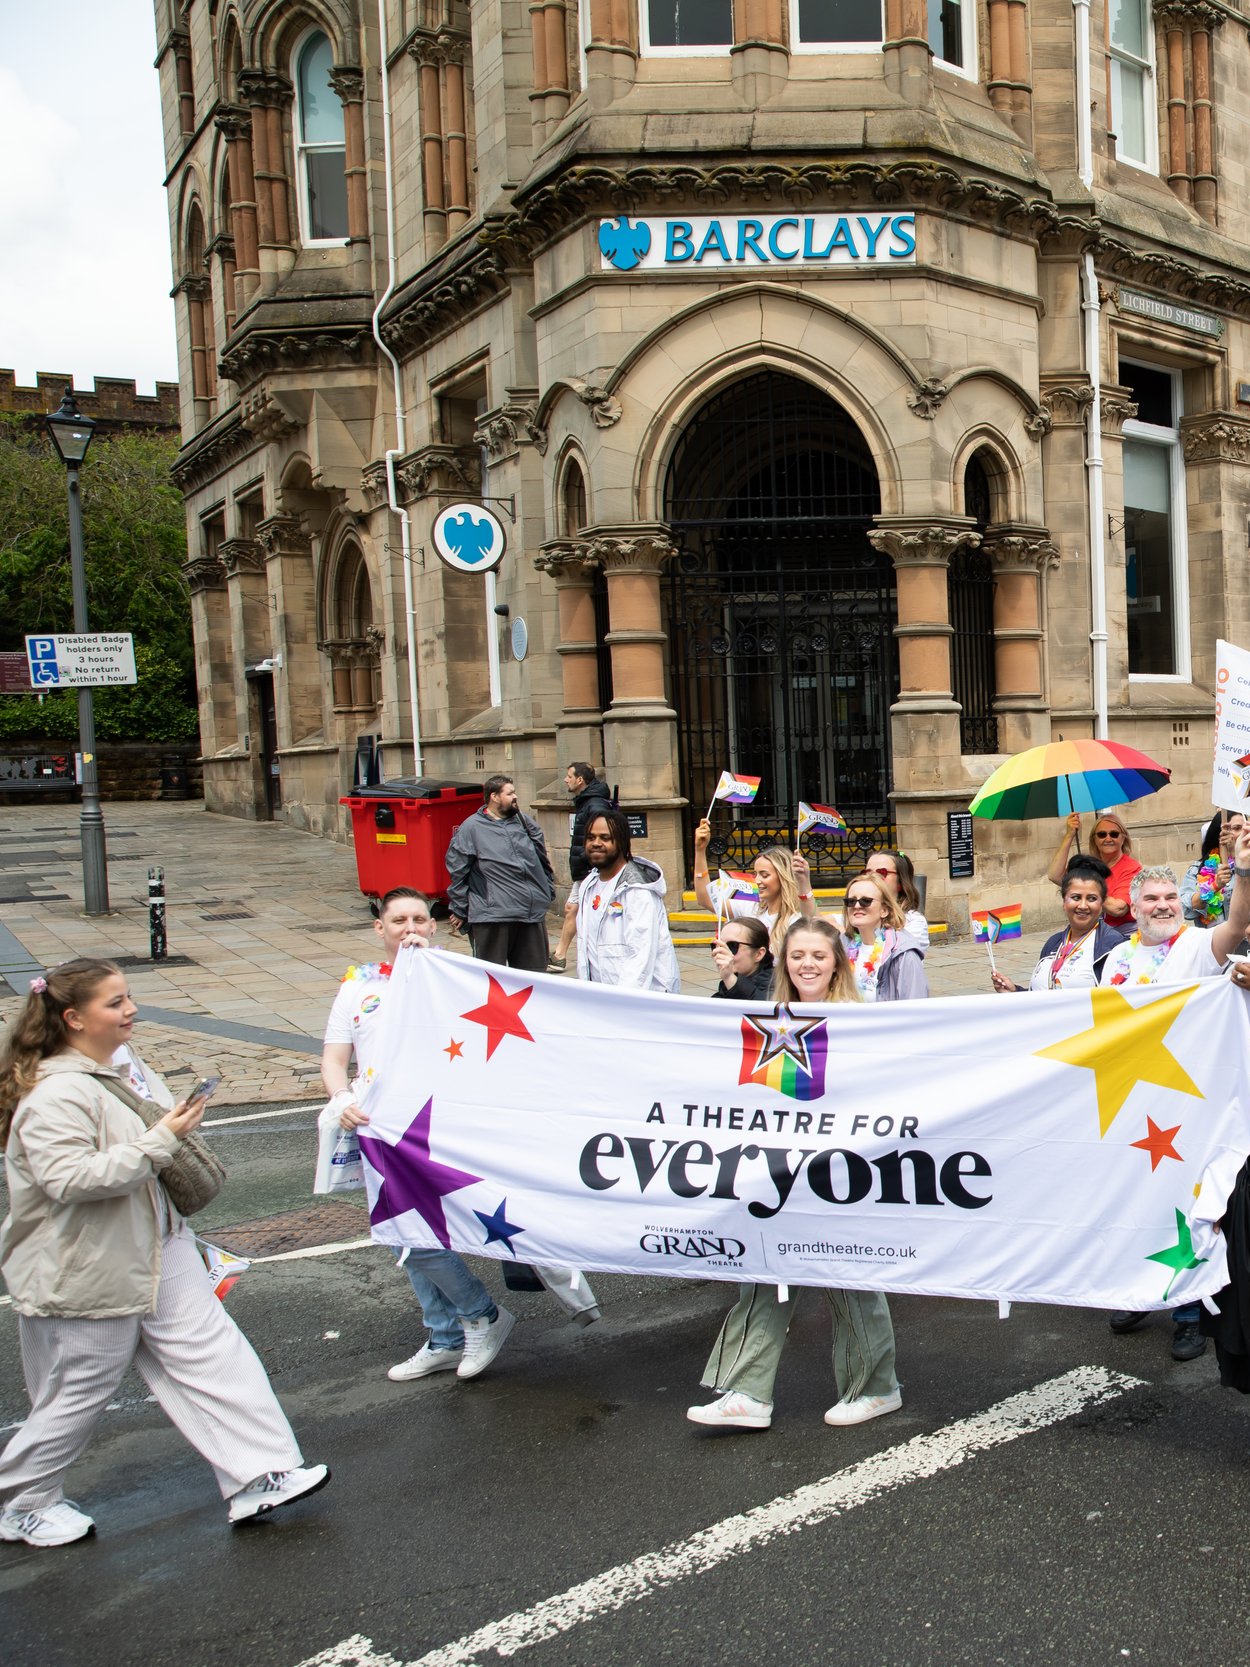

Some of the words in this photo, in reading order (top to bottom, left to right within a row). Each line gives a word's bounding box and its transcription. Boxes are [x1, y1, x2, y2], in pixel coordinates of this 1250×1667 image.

[664, 215, 916, 262] BARCLAYS
[1122, 291, 1172, 319] LICHFIELD
[1176, 310, 1213, 331] STREET
[35, 641, 52, 658] P
[1226, 720, 1236, 728] Be
[1221, 744, 1243, 755] Serve
[809, 814, 838, 825] GRAND
[646, 1102, 665, 1124] A
[682, 1104, 836, 1135] THEATRE
[851, 1115, 919, 1138] FOR
[579, 1132, 992, 1219] everyone
[644, 1224, 714, 1235] WOLVERHAMPTON
[640, 1234, 746, 1258] GRAND
[778, 1242, 917, 1258] grandtheatre.co.uk
